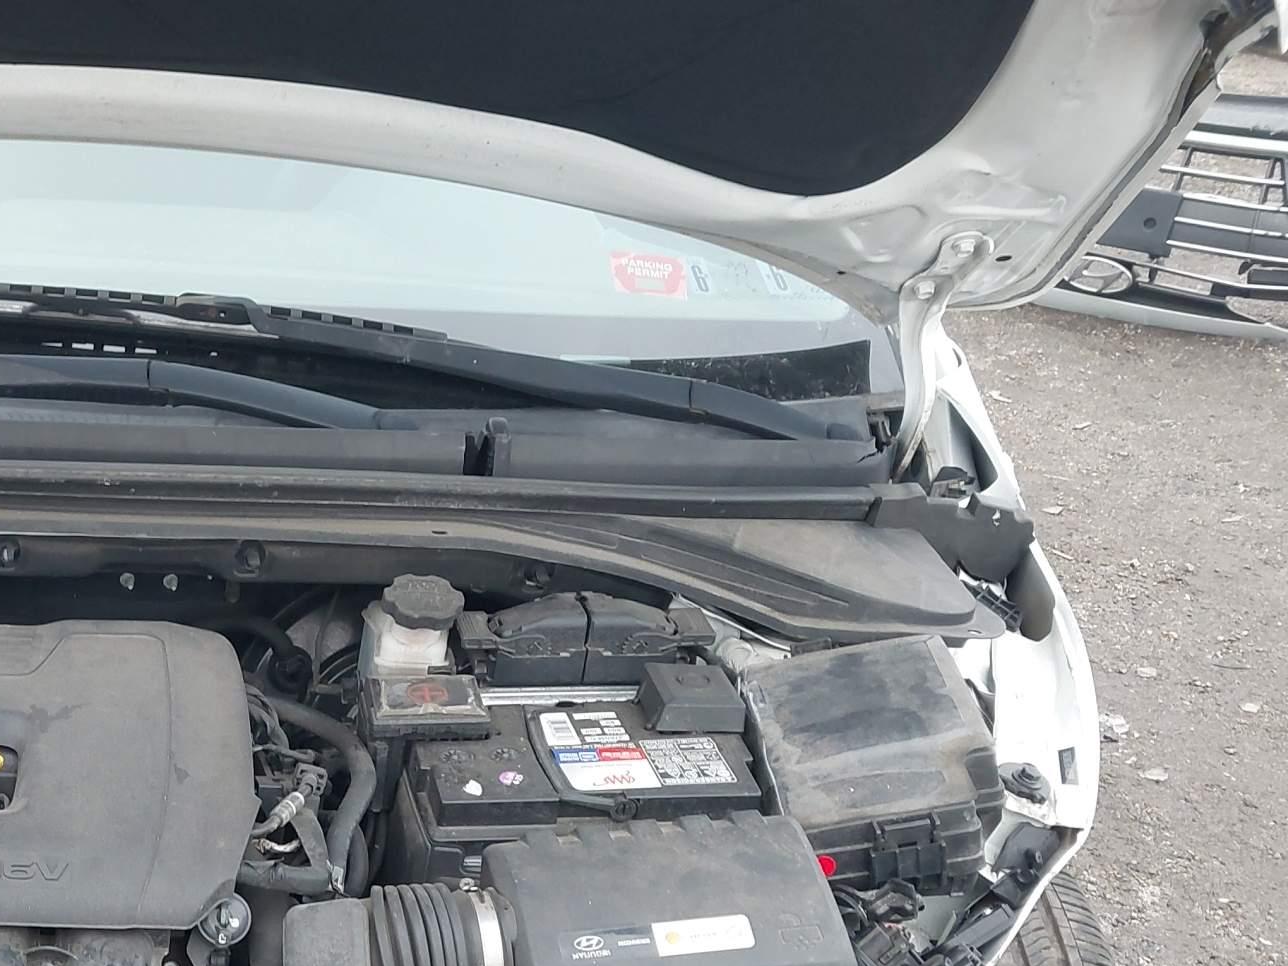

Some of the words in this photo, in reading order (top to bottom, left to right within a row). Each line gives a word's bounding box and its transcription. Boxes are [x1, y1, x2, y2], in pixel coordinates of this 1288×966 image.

[620, 257, 673, 272] PARKING
[627, 266, 672, 280] PERMIT
[691, 264, 710, 293] 6
